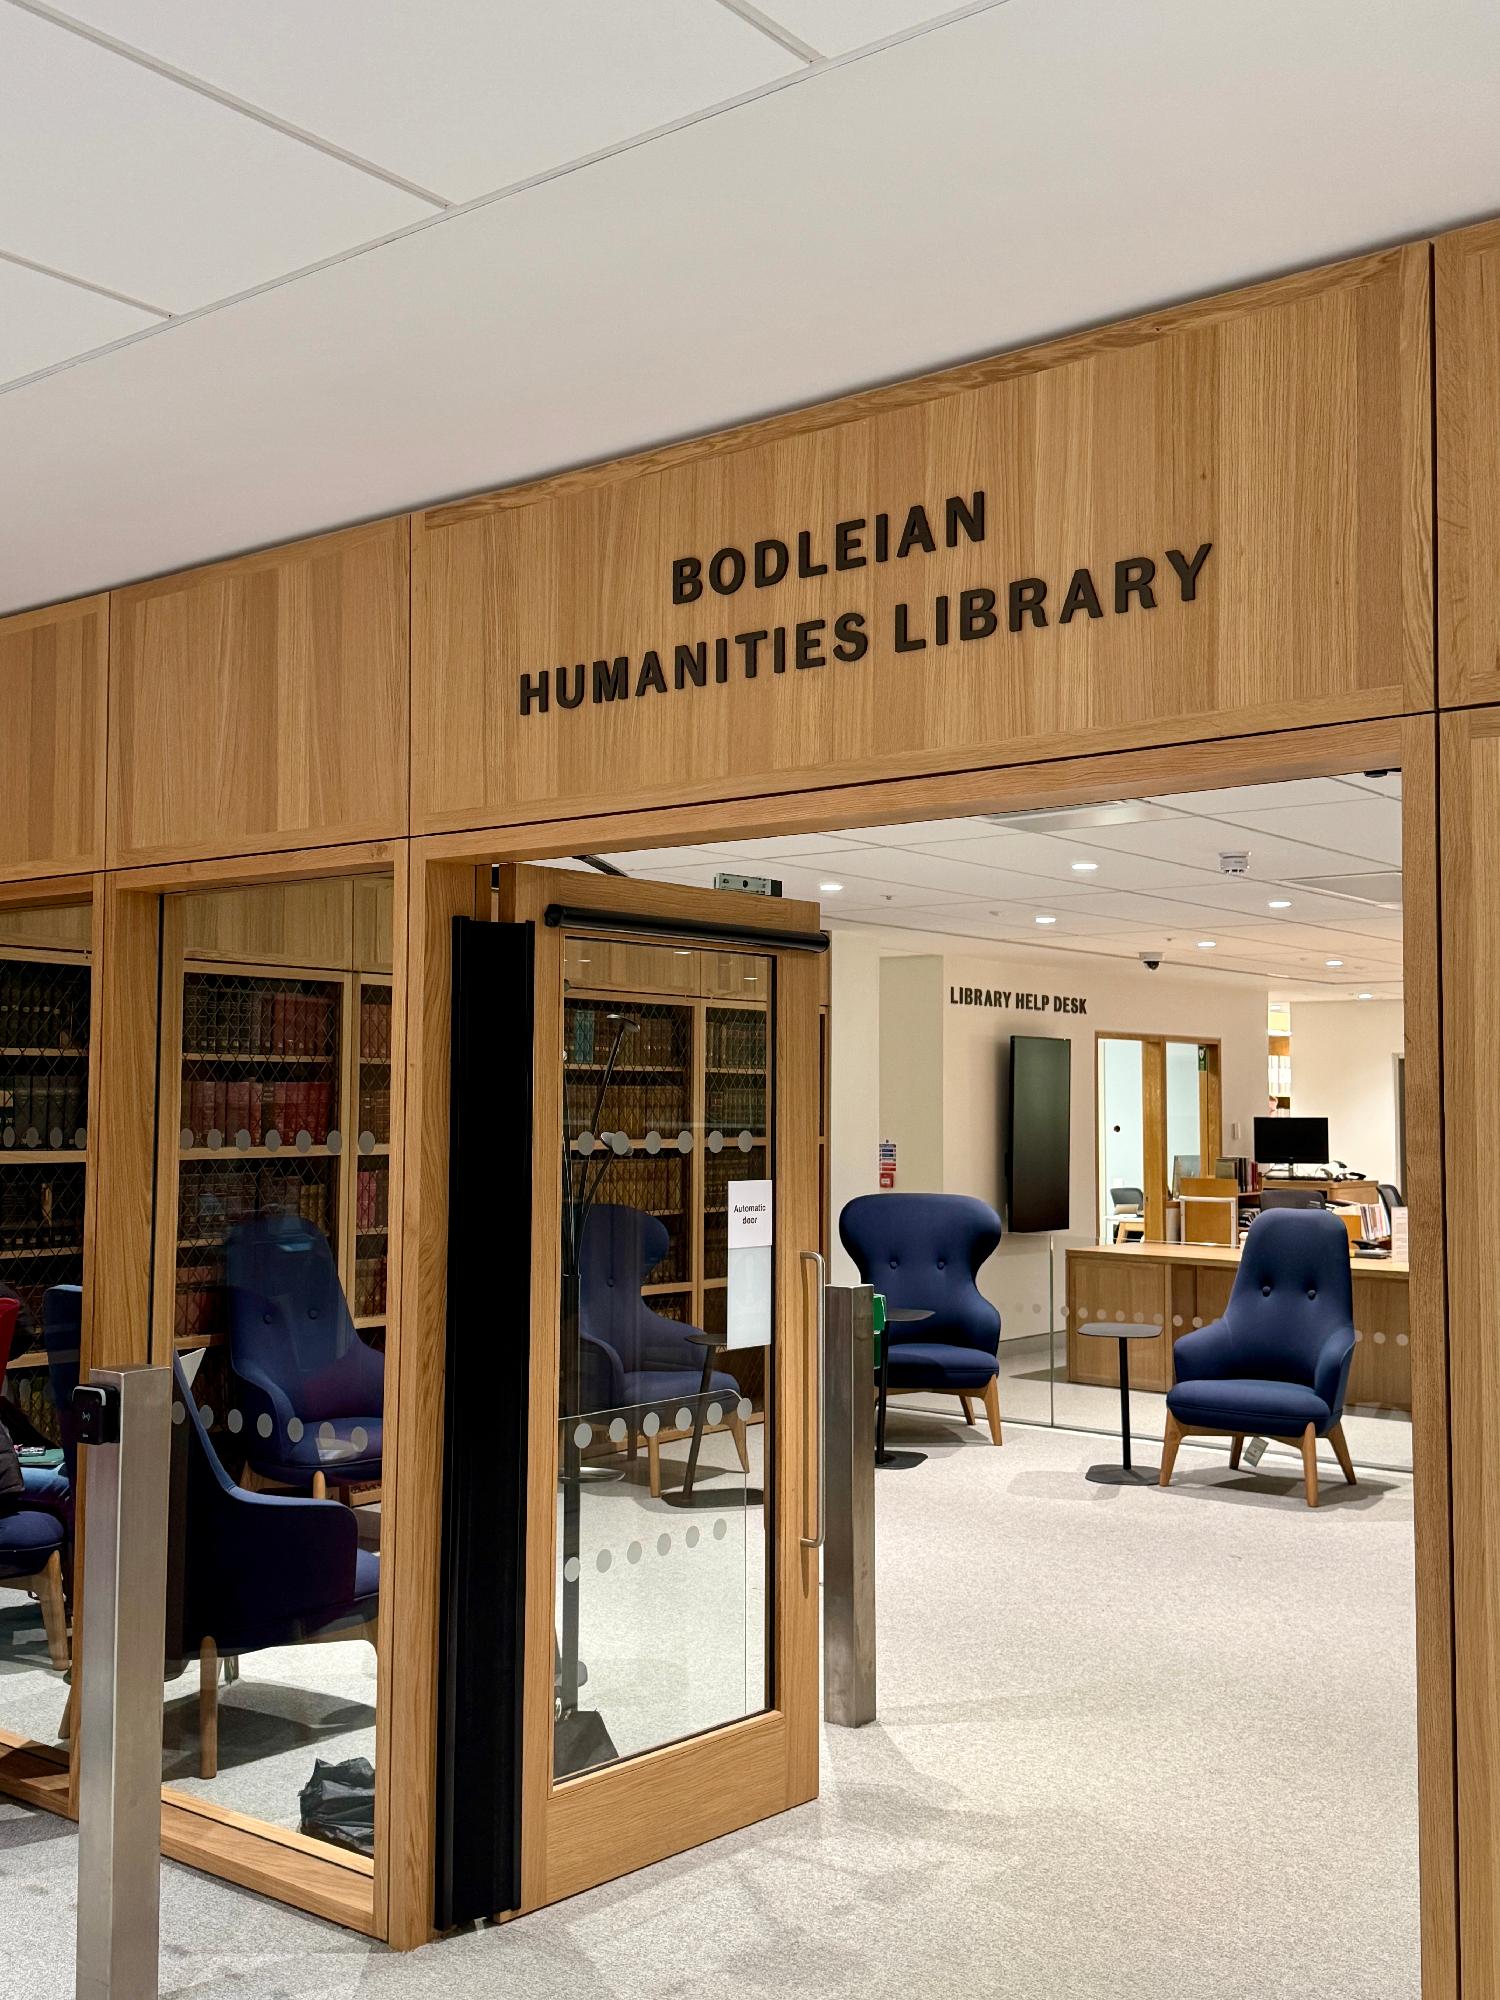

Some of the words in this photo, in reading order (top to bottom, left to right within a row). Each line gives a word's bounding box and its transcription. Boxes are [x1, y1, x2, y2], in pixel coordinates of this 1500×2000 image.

[672, 490, 985, 605] BODLEIAN
[520, 612, 869, 715] HUMANITIES
[895, 543, 1213, 653] LIBRARY
[950, 986, 1012, 1009] LIBRARY
[1015, 992, 1050, 1012] HELP
[1053, 995, 1087, 1015] DESK
[733, 1204, 766, 1213] Automatic
[742, 1216, 758, 1225] door
